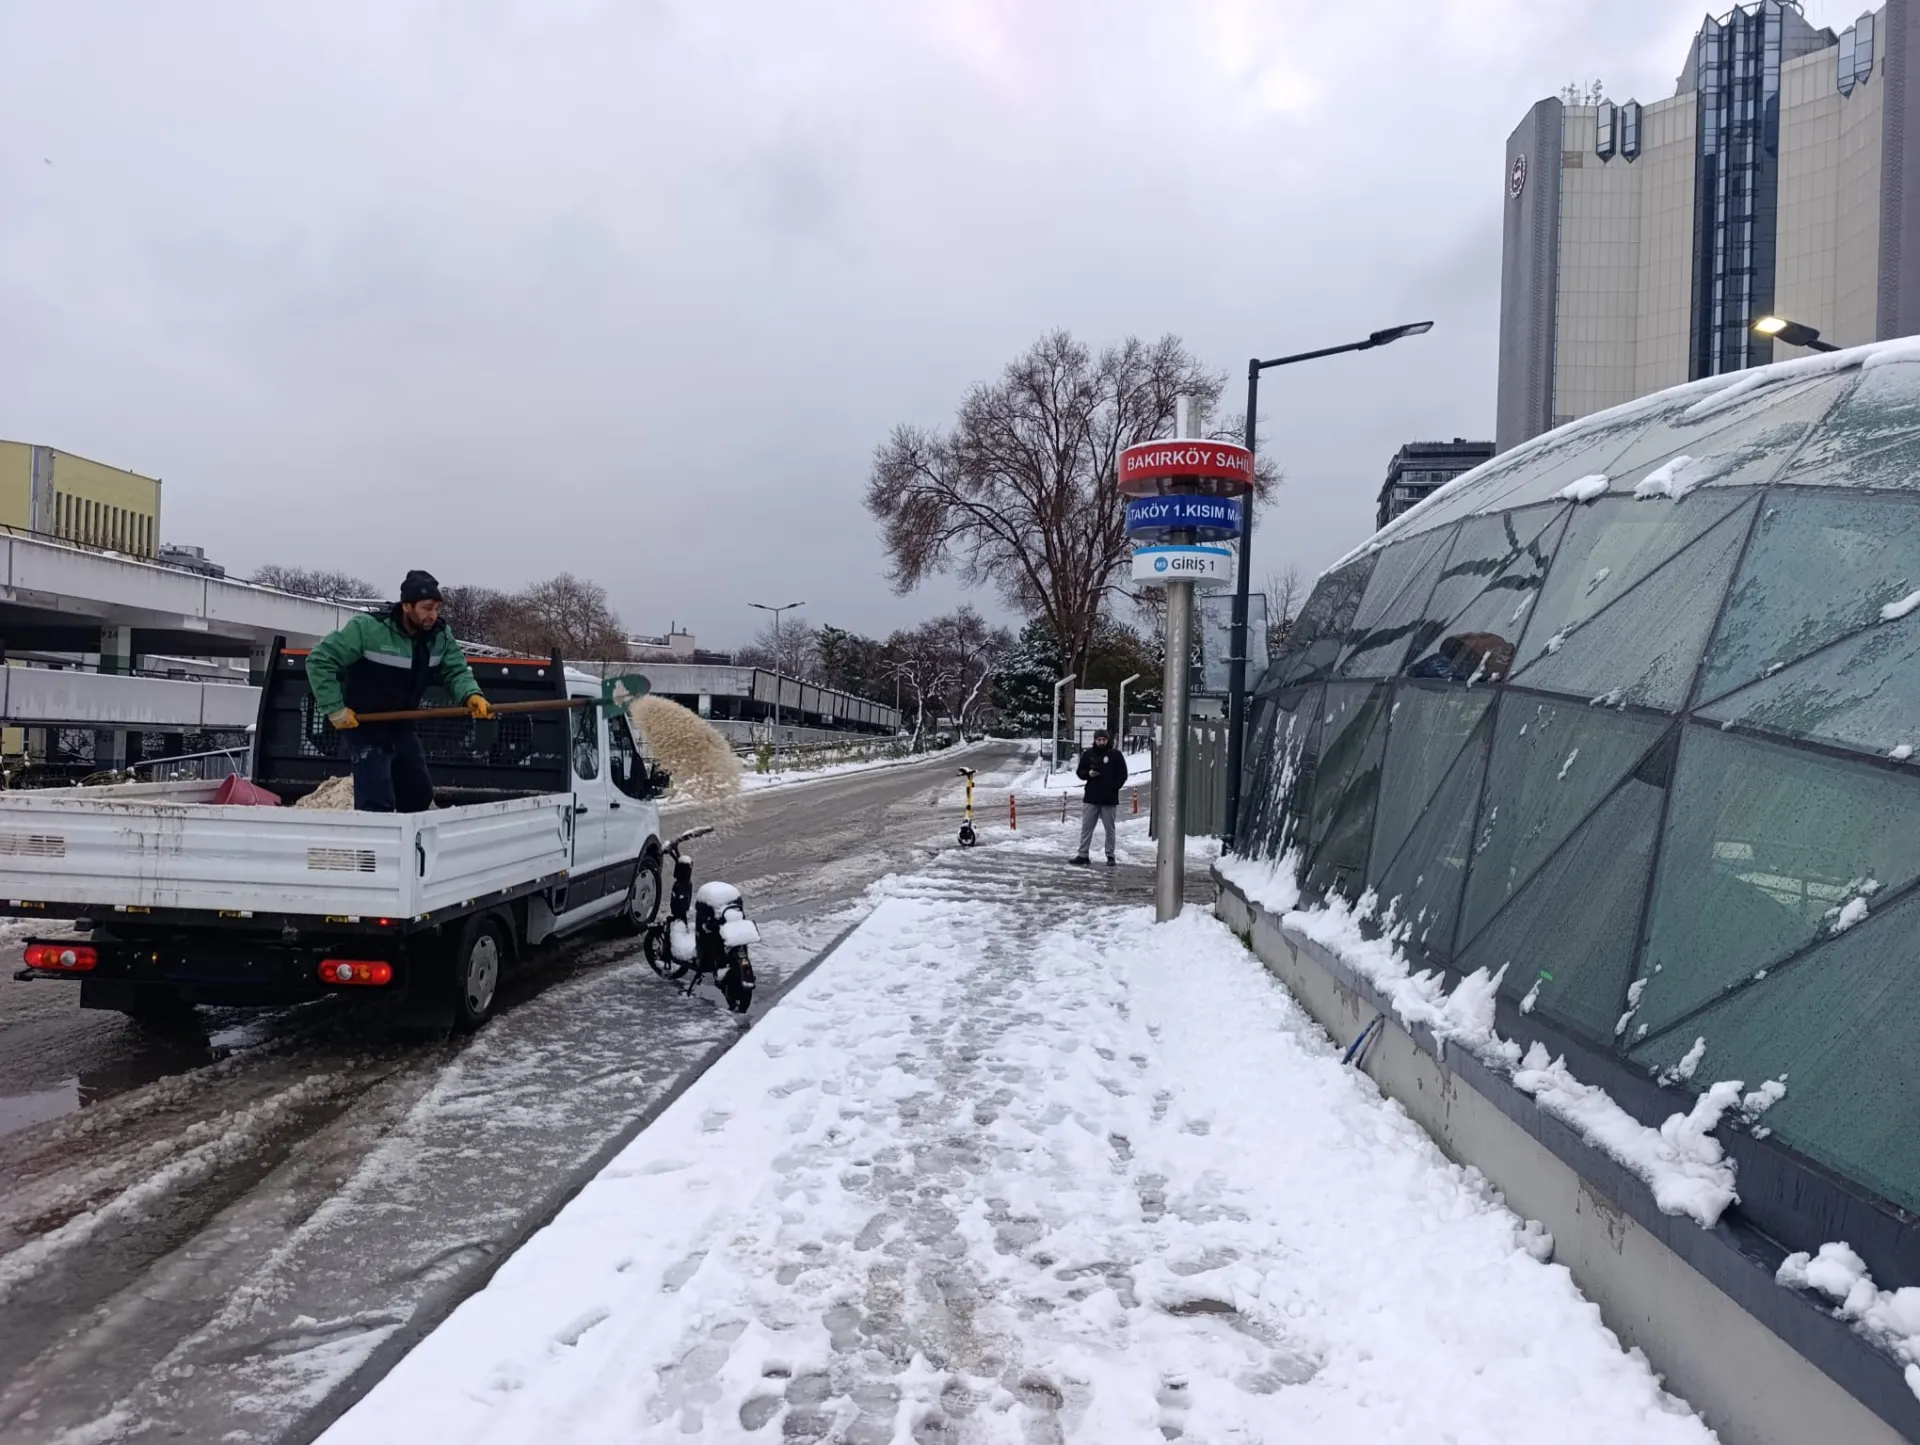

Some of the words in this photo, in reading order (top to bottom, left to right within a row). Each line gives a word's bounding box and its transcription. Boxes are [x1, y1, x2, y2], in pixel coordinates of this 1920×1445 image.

[1127, 447, 1211, 471] BAKIRKÖY
[1216, 452, 1250, 474] SAHİL
[1173, 504, 1225, 519] 1.KISIM
[1227, 508, 1242, 522] MA
[1171, 556, 1205, 573] GİRİŞ
[1209, 560, 1215, 572] 1
